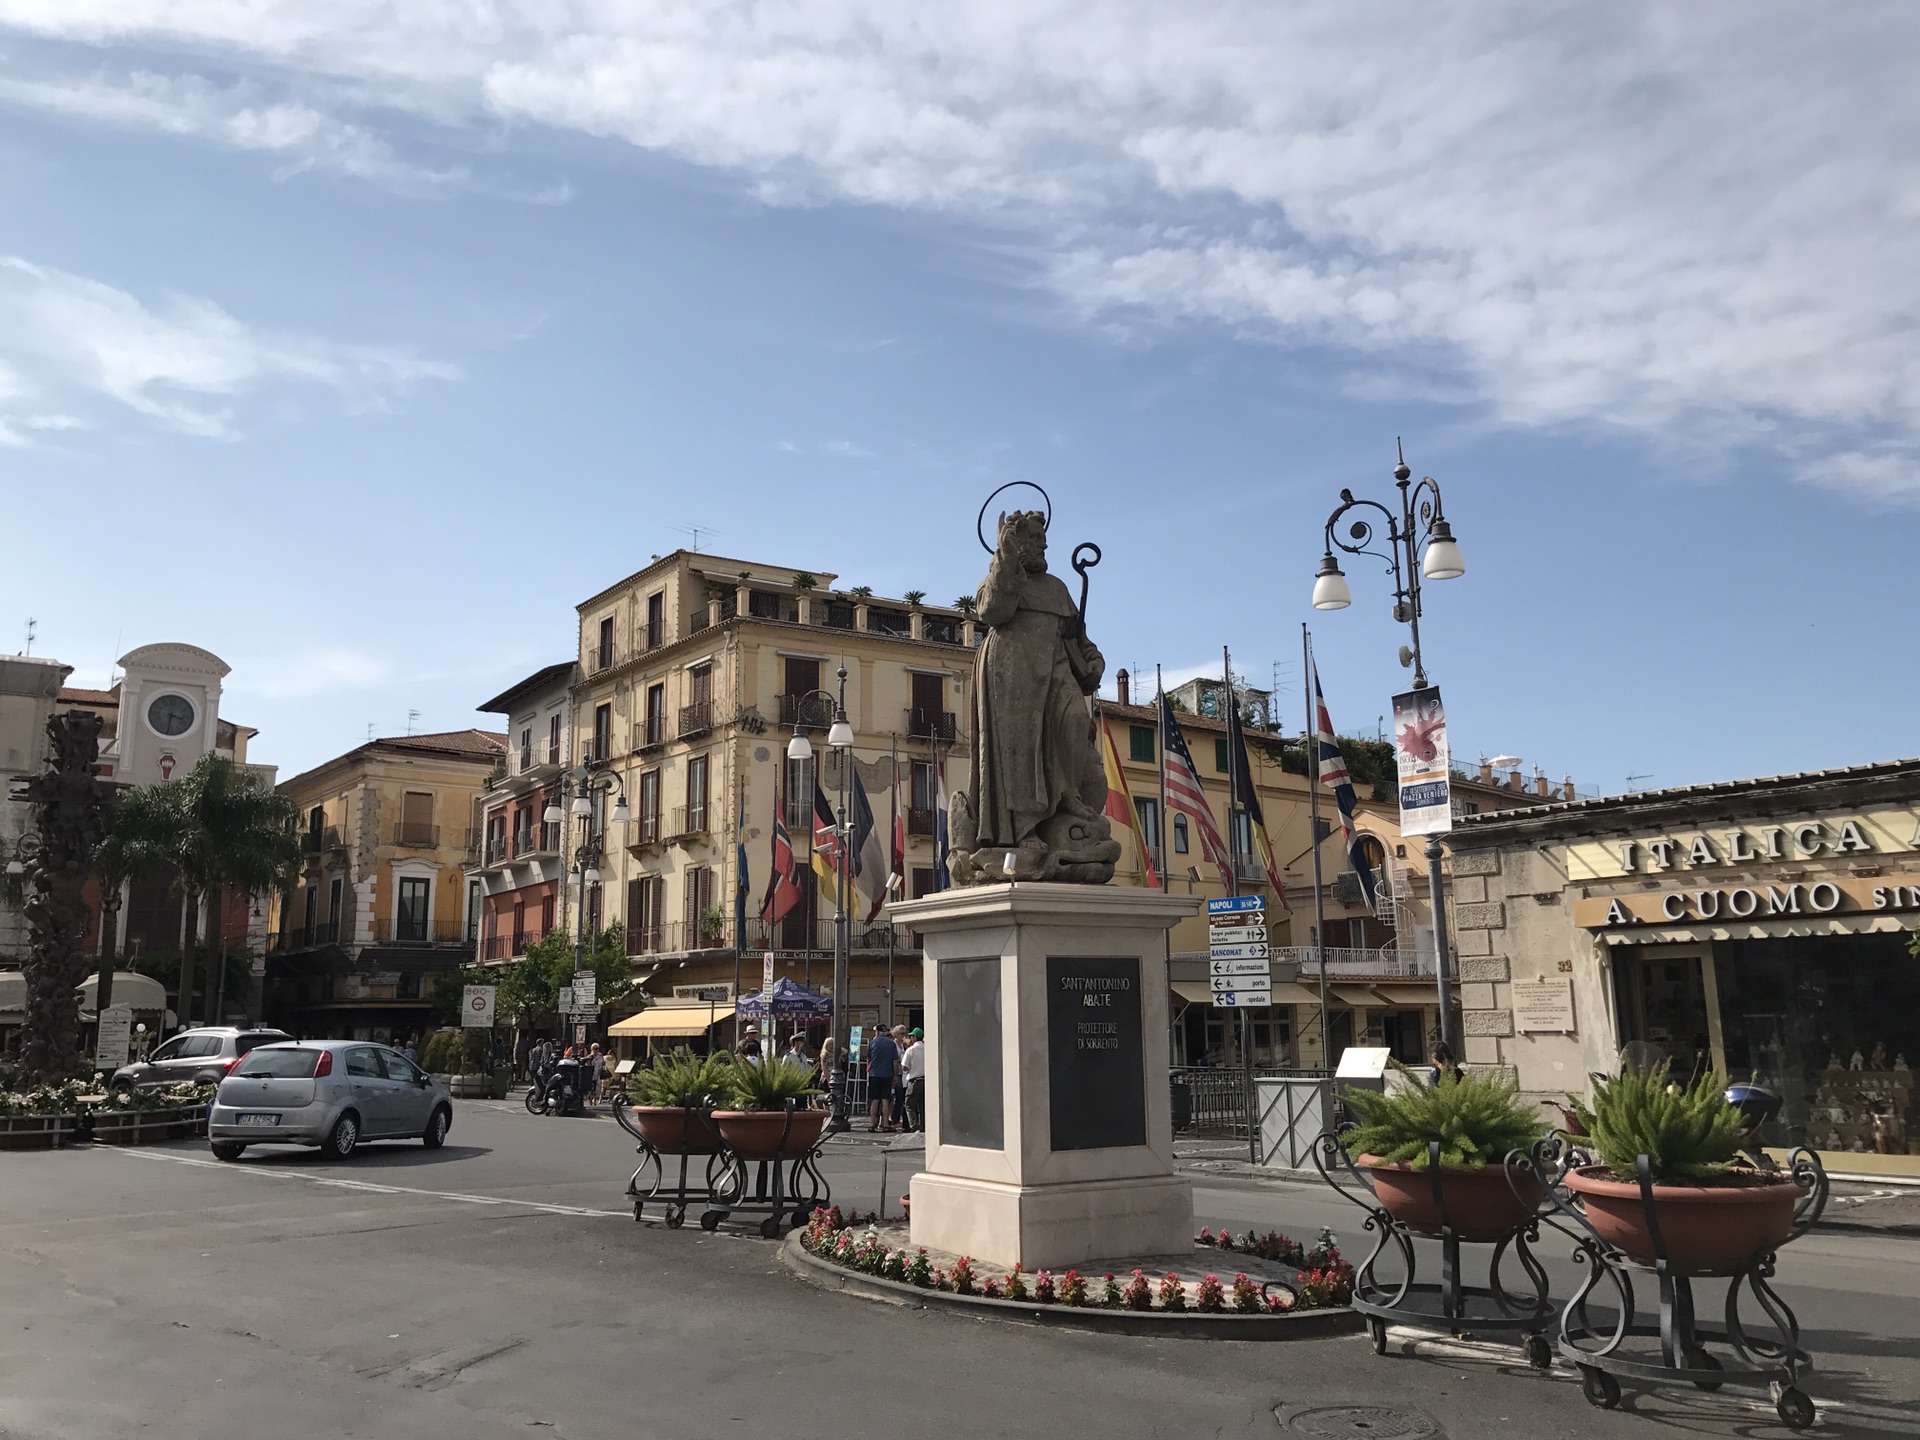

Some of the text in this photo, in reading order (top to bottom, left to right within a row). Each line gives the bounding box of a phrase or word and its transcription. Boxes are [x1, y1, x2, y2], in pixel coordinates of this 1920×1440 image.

[1402, 788, 1448, 802] PIAZZA VENIERO
[1620, 820, 1870, 872] ITALICA
[1210, 901, 1233, 910] NAPOLI
[1604, 898, 1637, 925] A.
[1662, 882, 1840, 921] CUOMO
[1557, 960, 1573, 972] 32
[1061, 977, 1130, 990] SANT'ANTONINO
[1083, 993, 1111, 1006] ABATE
[1077, 1022, 1117, 1034] PROTETTORE
[1078, 1037, 1118, 1049] DI SORRENTO
